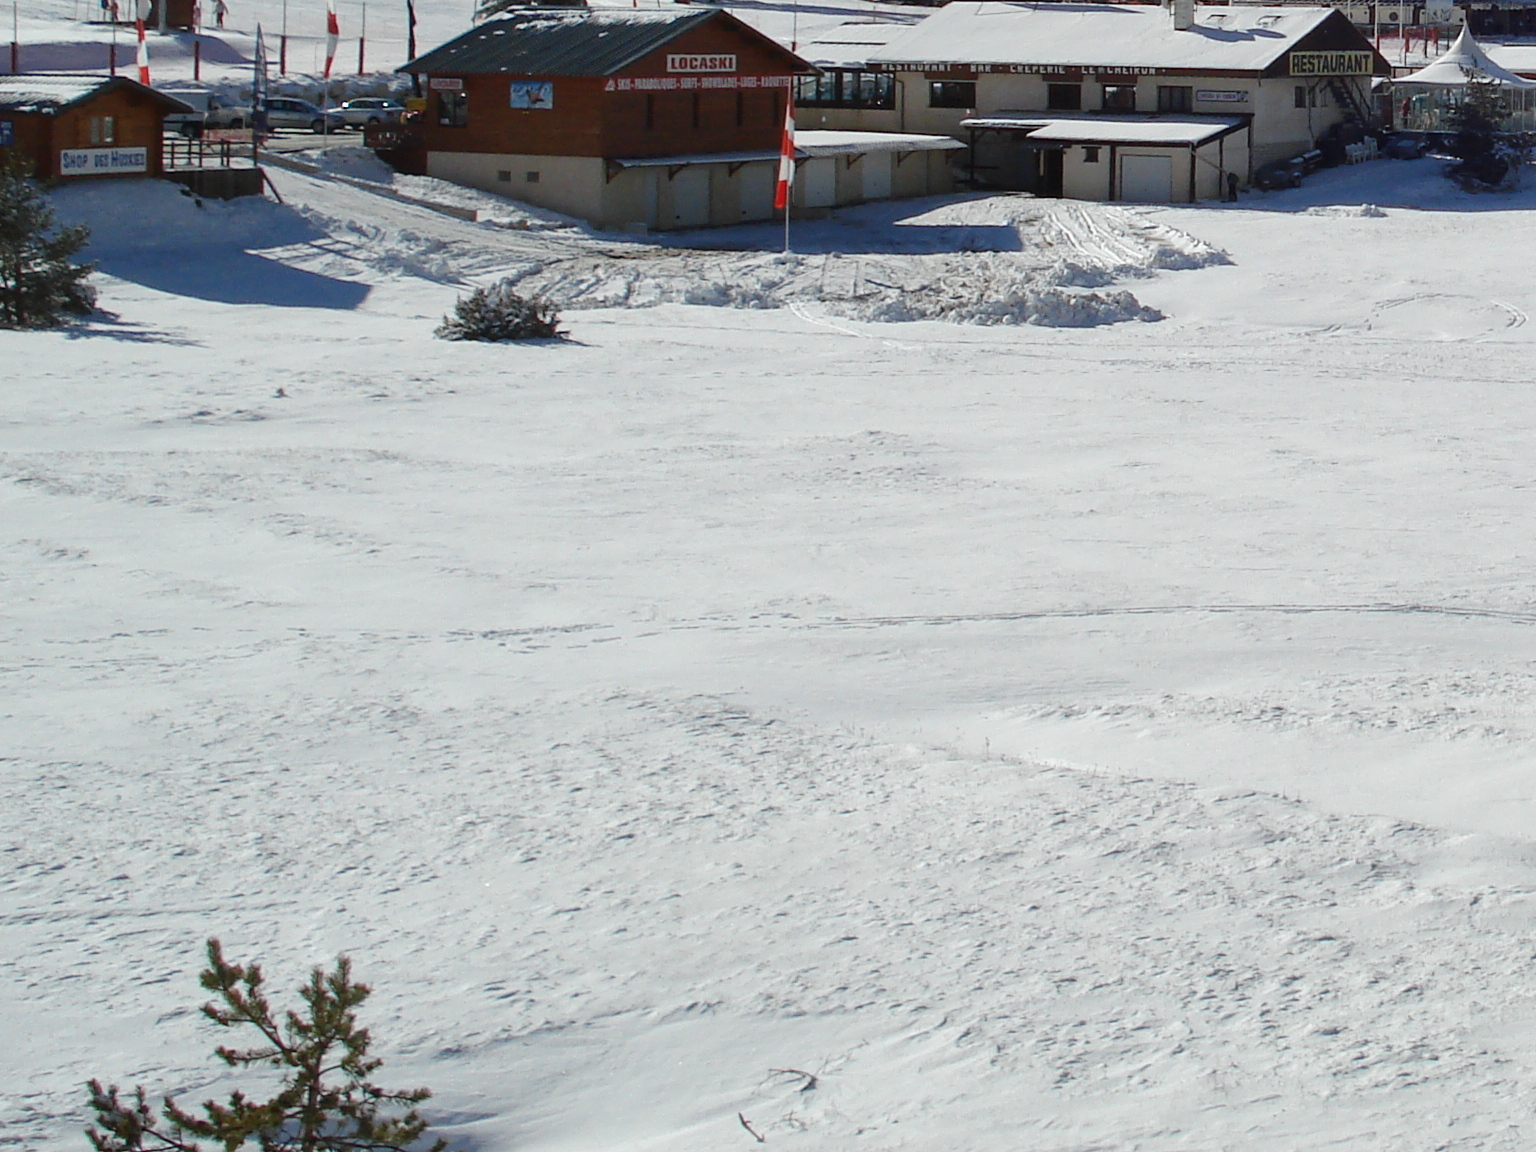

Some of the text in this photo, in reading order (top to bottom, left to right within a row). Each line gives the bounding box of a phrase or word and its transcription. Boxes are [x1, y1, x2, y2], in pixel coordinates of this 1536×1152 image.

[671, 57, 733, 70] LOCASKI
[881, 63, 951, 72] RESTAURANT
[970, 64, 992, 73] BAR
[1292, 54, 1370, 73] RESTAURANT
[63, 150, 145, 168] SHOP DES HUSKIES
